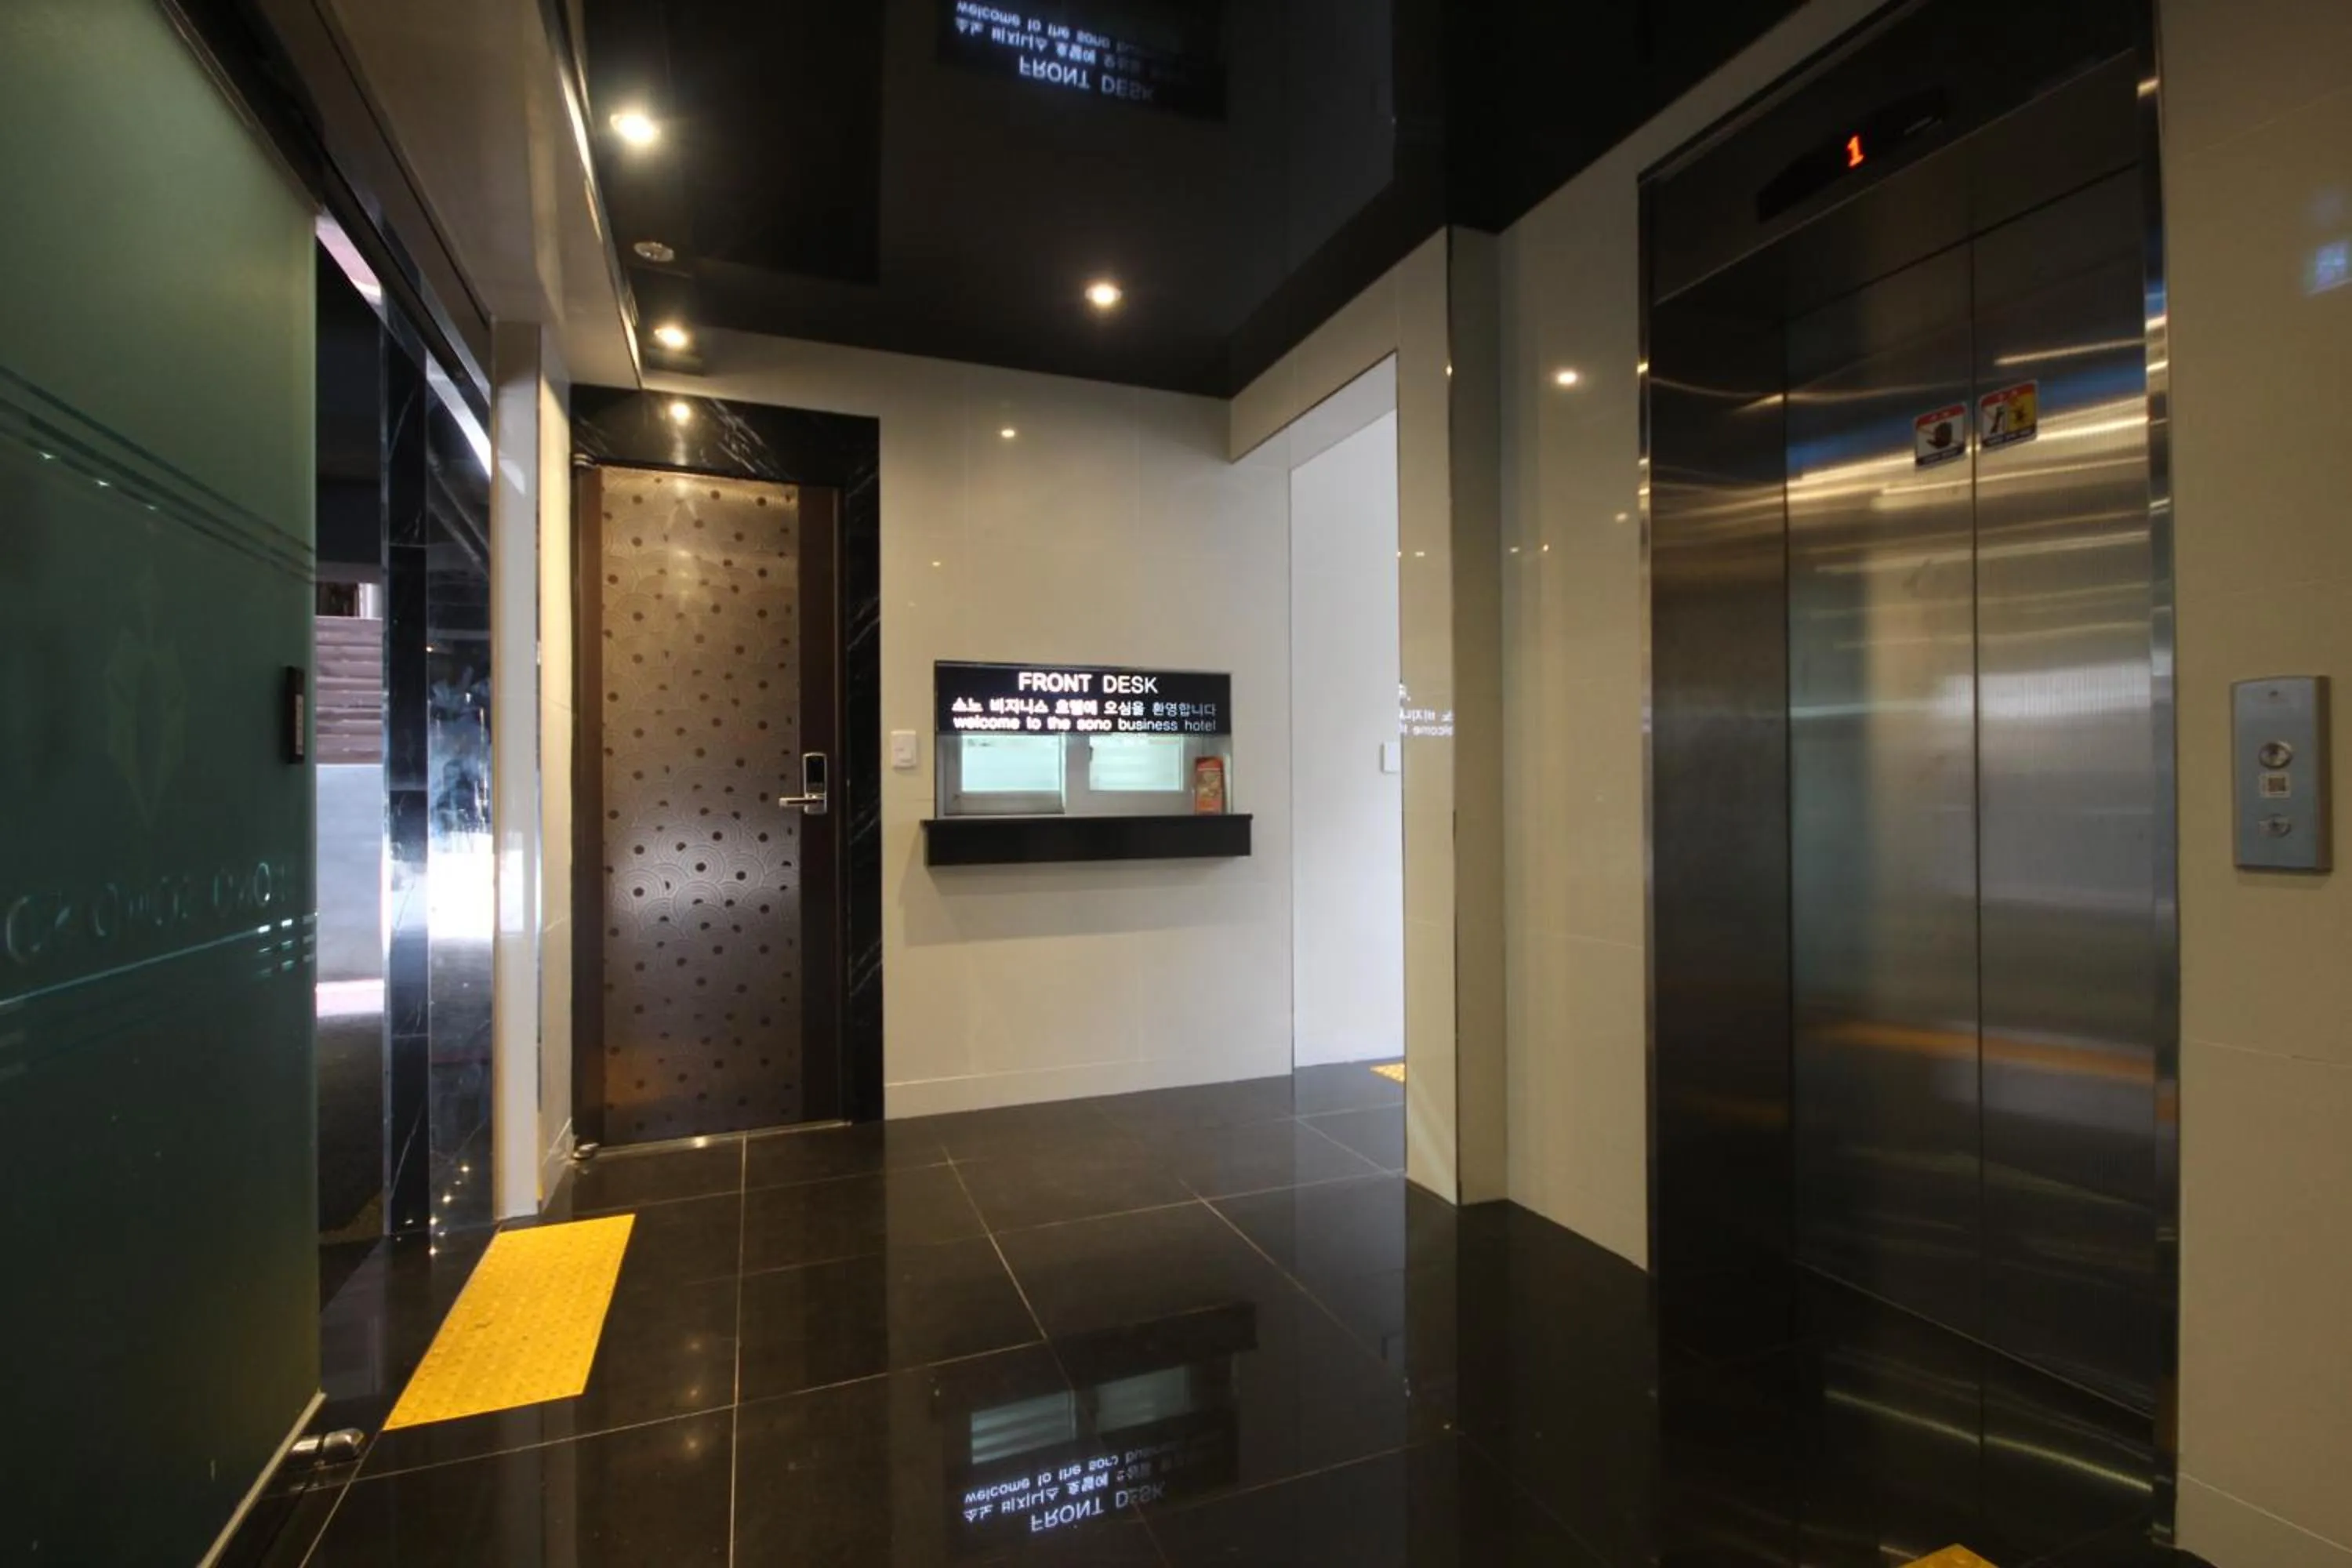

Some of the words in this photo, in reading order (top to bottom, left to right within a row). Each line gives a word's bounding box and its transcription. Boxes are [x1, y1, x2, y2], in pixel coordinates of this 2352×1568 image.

[1847, 135, 1864, 168] 1
[1018, 672, 1092, 693] FRONT
[1102, 674, 1159, 695] DESK
[989, 697, 1049, 714] 비지니스
[1055, 699, 1098, 715] 호텔에
[1104, 701, 1145, 716] 오심을
[1152, 702, 1217, 717] 환영합니다
[953, 714, 1020, 730] welcome
[1025, 716, 1042, 730] to
[1047, 717, 1071, 731] the
[1077, 718, 1112, 731] sono
[1118, 718, 1178, 731] business
[1185, 720, 1216, 731] hotel
